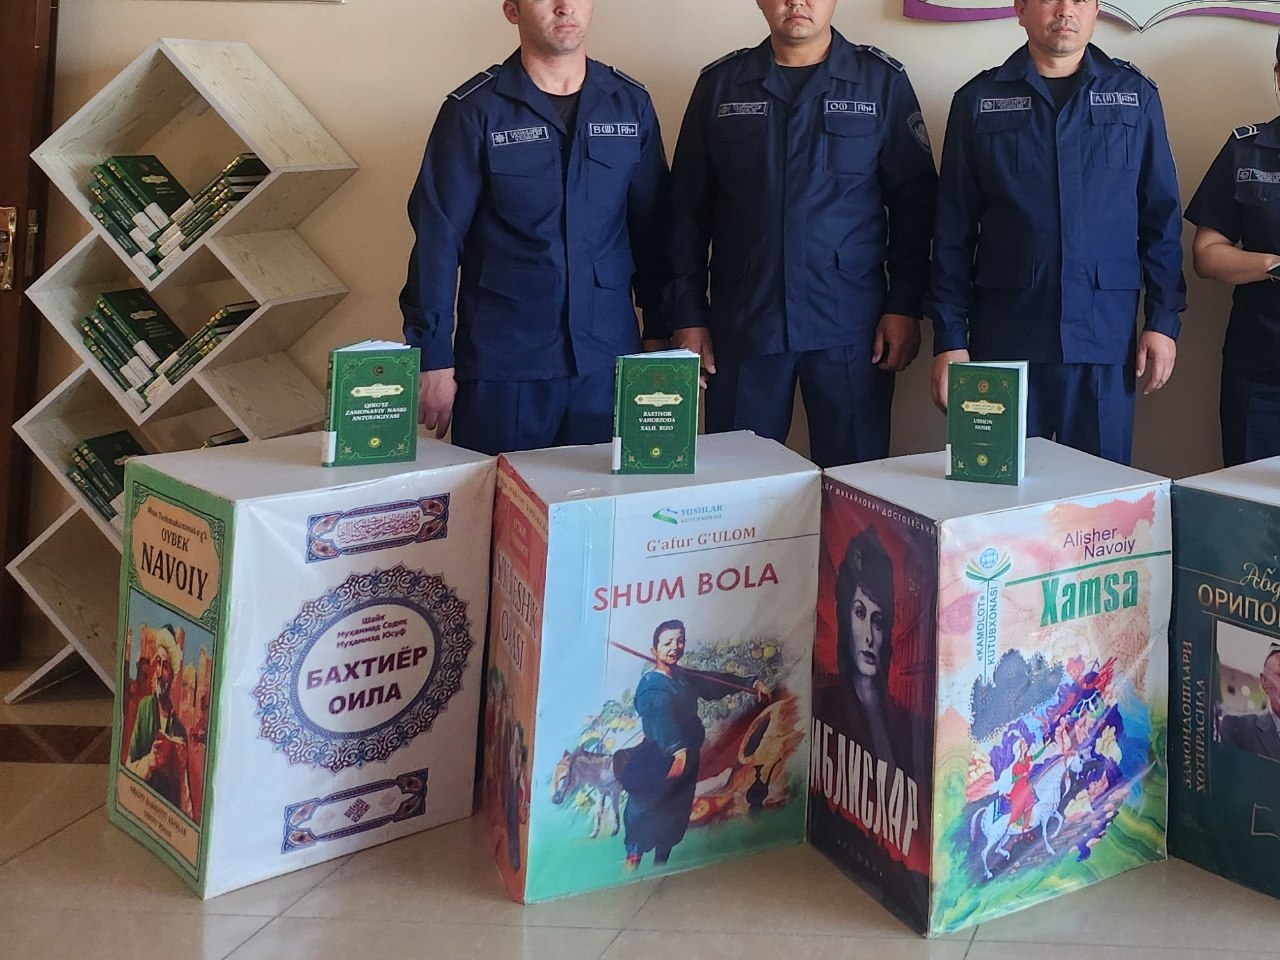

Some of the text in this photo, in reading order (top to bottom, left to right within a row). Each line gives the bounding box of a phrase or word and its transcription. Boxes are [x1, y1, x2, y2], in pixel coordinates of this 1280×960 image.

[681, 505, 722, 516] YOSHLAR
[881, 508, 934, 534] ДОСТОЕВСКИЙ
[162, 528, 190, 552] OYBEK
[1063, 527, 1118, 549] Alisher
[1084, 540, 1136, 560] Navoiy
[141, 542, 208, 601] NAVOIY
[592, 562, 779, 611] SHUM BOLA
[1040, 570, 1139, 627] Xamsa
[362, 614, 385, 624] Шайх
[988, 586, 998, 665] KUTUBXONASI
[382, 628, 406, 639] Юсуф
[307, 646, 428, 690] БАХТИЁР
[328, 682, 402, 715] ОИЛА
